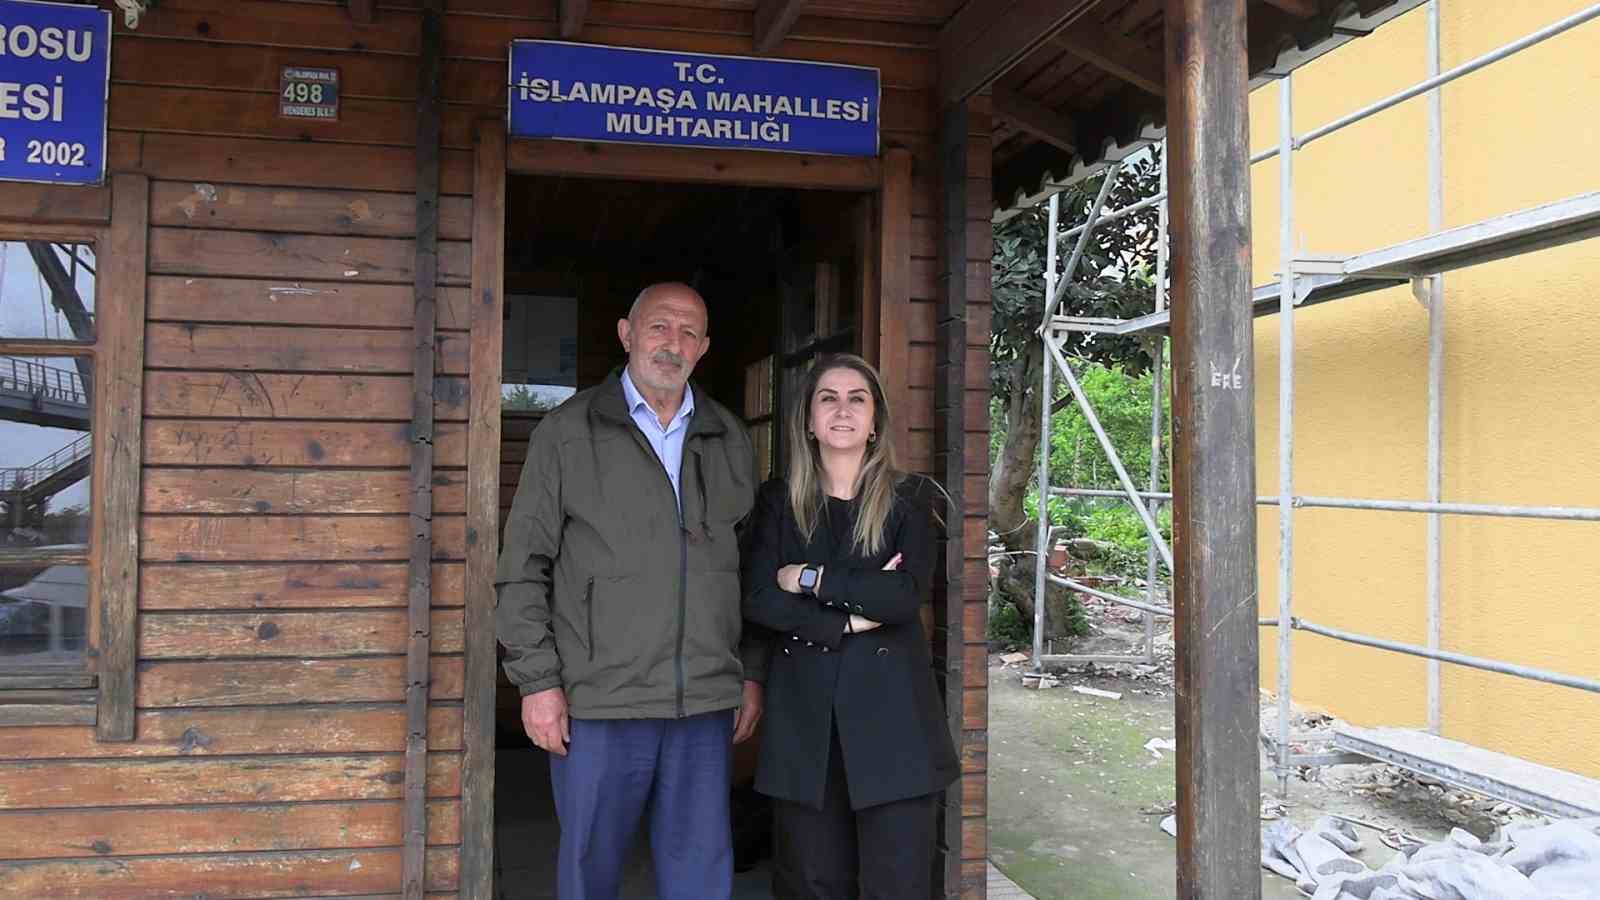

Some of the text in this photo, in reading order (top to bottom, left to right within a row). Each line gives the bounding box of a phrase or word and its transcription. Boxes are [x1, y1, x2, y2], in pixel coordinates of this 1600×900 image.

[0, 24, 92, 62] OSU
[673, 61, 725, 84] T.C.
[284, 83, 322, 103] 498
[519, 71, 869, 122] İSLAMPAŞA MAHALLESİ
[606, 112, 790, 142] MUHTARLIĞI
[27, 139, 85, 166] 2002
